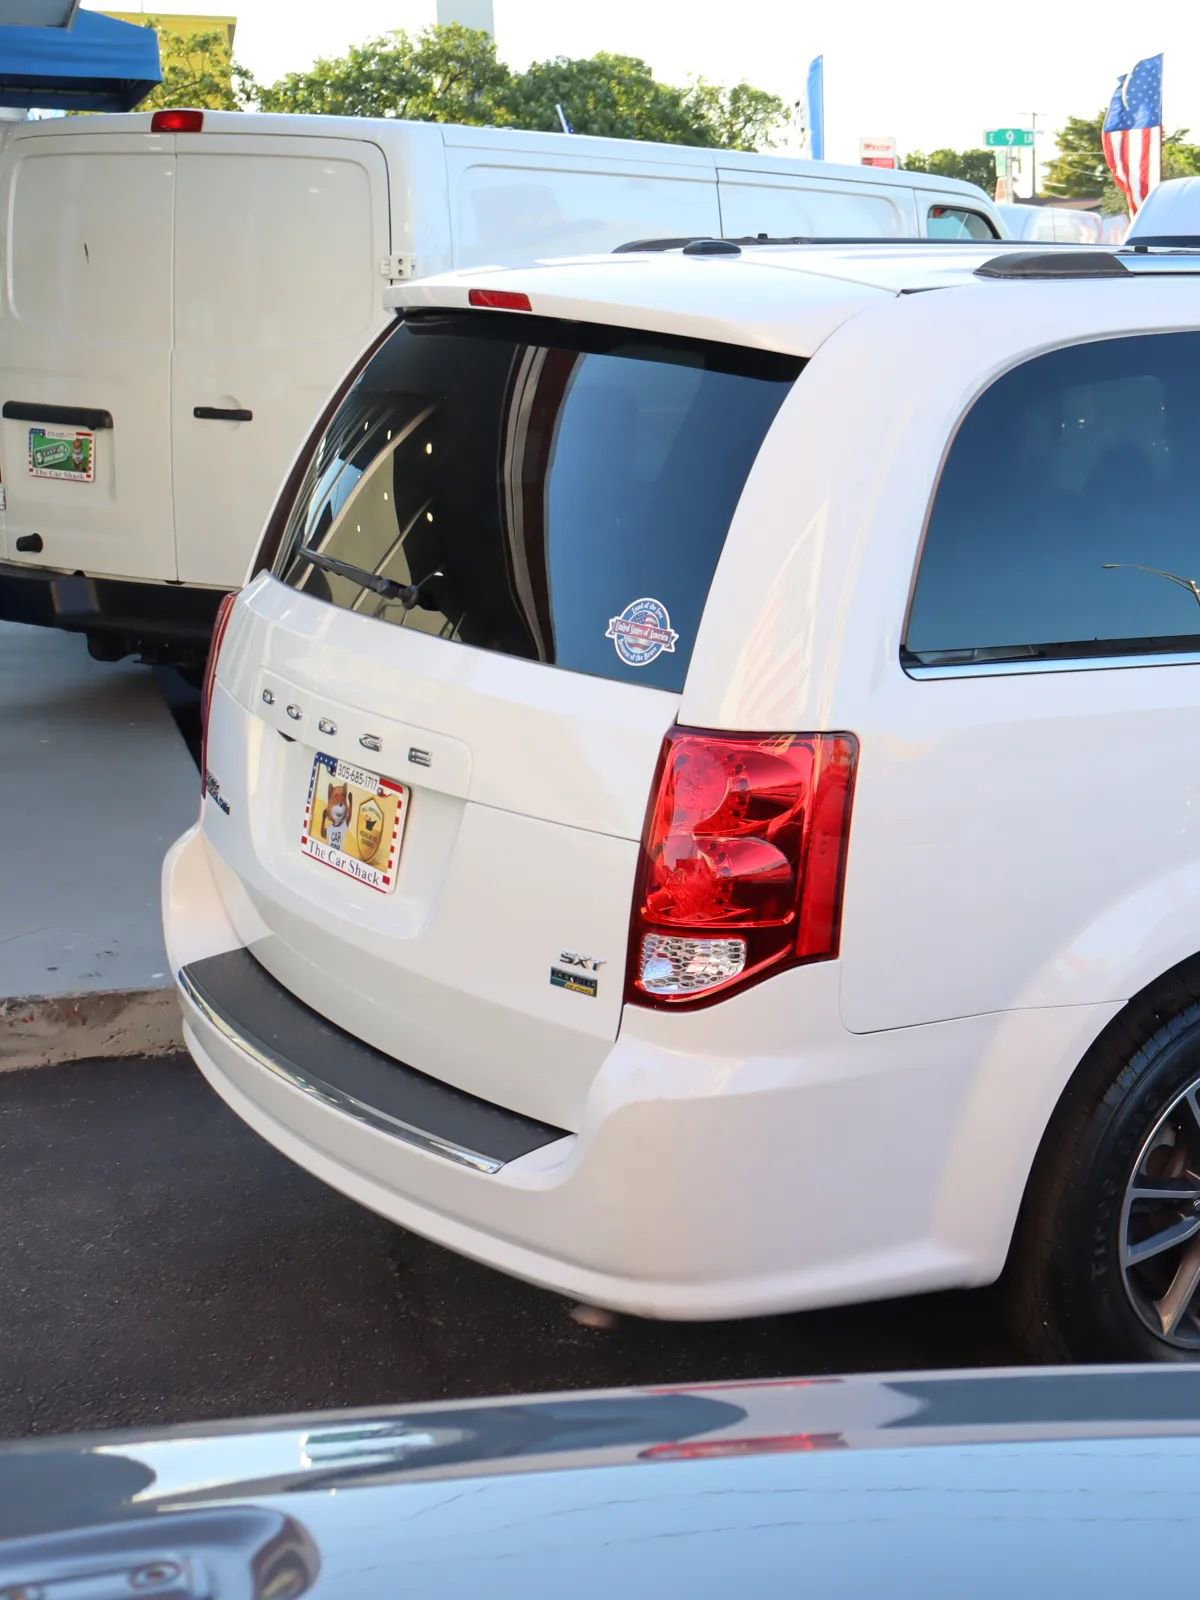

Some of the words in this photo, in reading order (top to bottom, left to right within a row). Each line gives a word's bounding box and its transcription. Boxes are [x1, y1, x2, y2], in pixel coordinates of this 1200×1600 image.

[1005, 130, 1015, 146] 9
[262, 687, 434, 769] DODGE
[337, 763, 378, 792] 305-685-1717
[331, 831, 342, 844] CAR
[309, 839, 327, 860] The
[327, 849, 347, 870] Car
[348, 858, 381, 887] Shack
[559, 951, 608, 971] SXT
